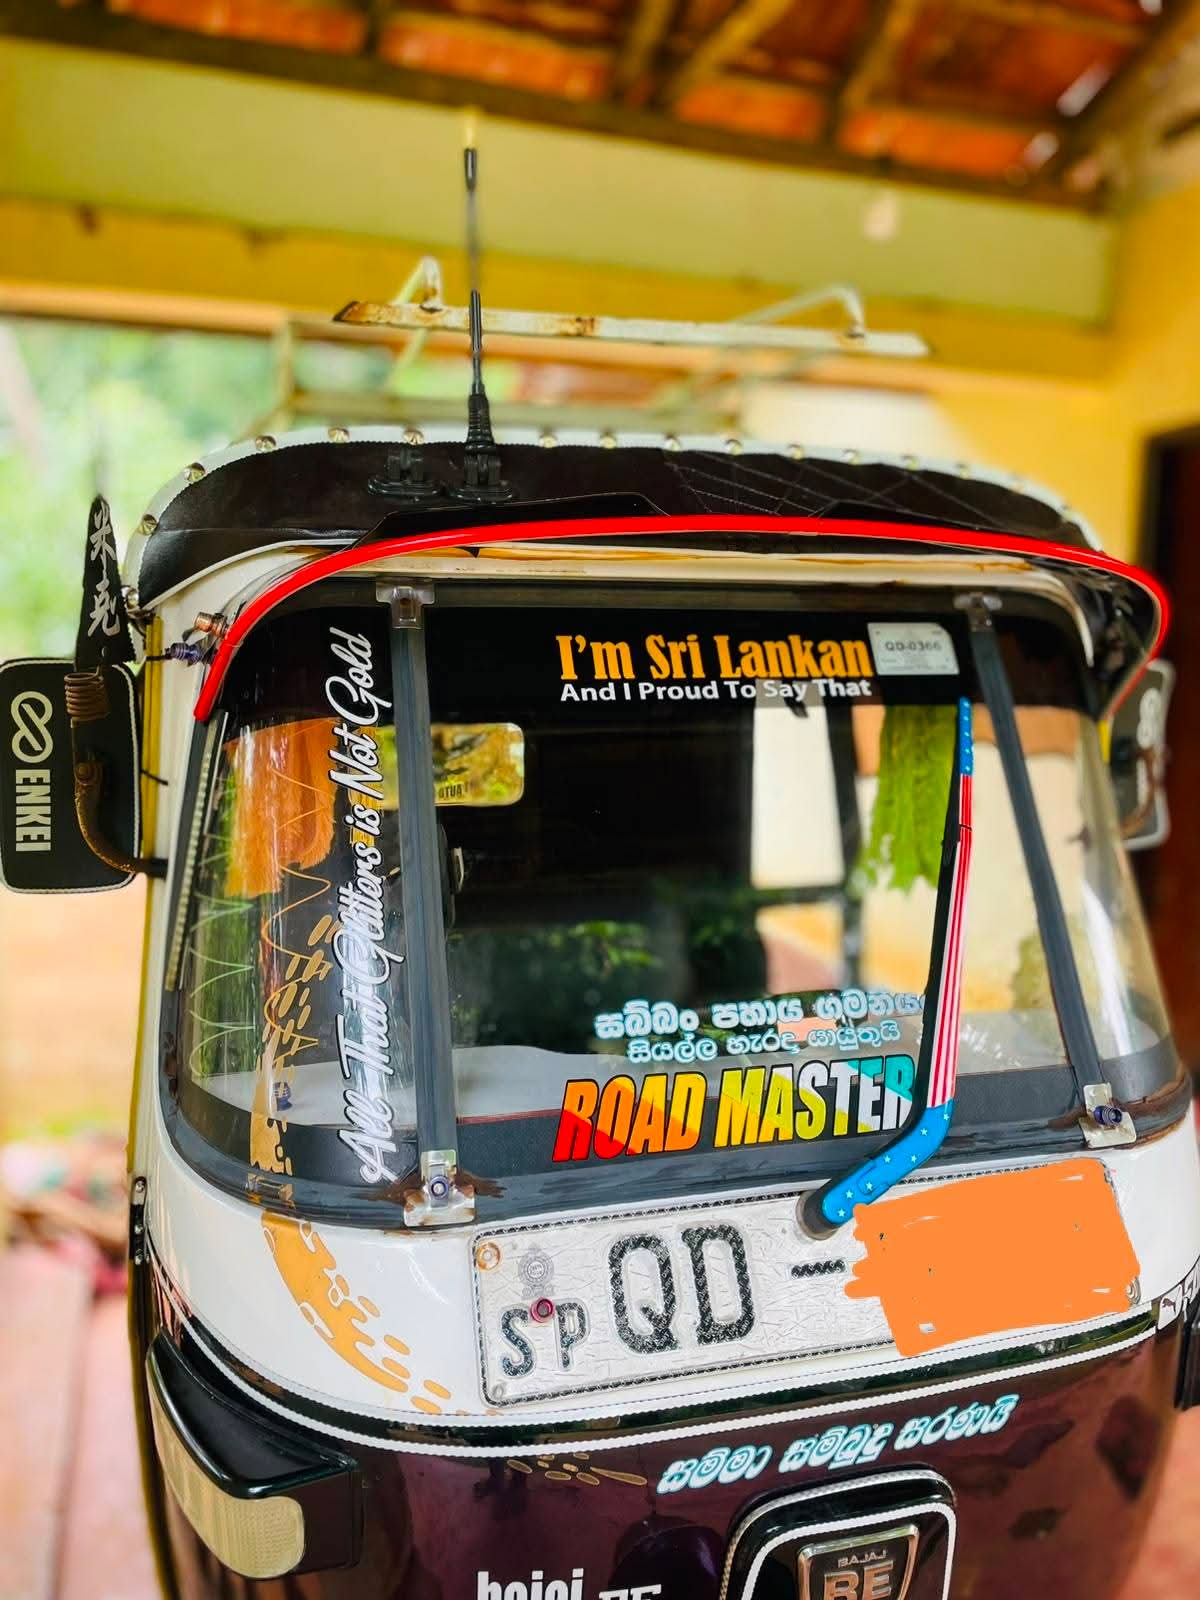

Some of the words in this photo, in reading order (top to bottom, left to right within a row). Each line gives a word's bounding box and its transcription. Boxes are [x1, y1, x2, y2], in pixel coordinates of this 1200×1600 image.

[325, 626, 393, 726] Gold
[556, 634, 635, 680] I'm
[646, 634, 706, 679] Sri
[713, 634, 873, 679] Lankan
[560, 682, 616, 702] And
[623, 683, 632, 701] I
[638, 680, 719, 700] Proud
[723, 680, 757, 699] To
[763, 680, 808, 701] Say
[811, 679, 872, 697] That
[328, 722, 385, 800] Not
[15, 769, 52, 852] ENKEI
[344, 803, 382, 836] is
[332, 841, 405, 985] Glitters
[336, 988, 394, 1080] That
[338, 1088, 399, 1184] All
[552, 1070, 708, 1163] ROAD
[713, 1054, 915, 1148] MASTER
[608, 1223, 756, 1354] QD
[824, 1560, 894, 1600] RE
[838, 1550, 887, 1568] BAJAJ
